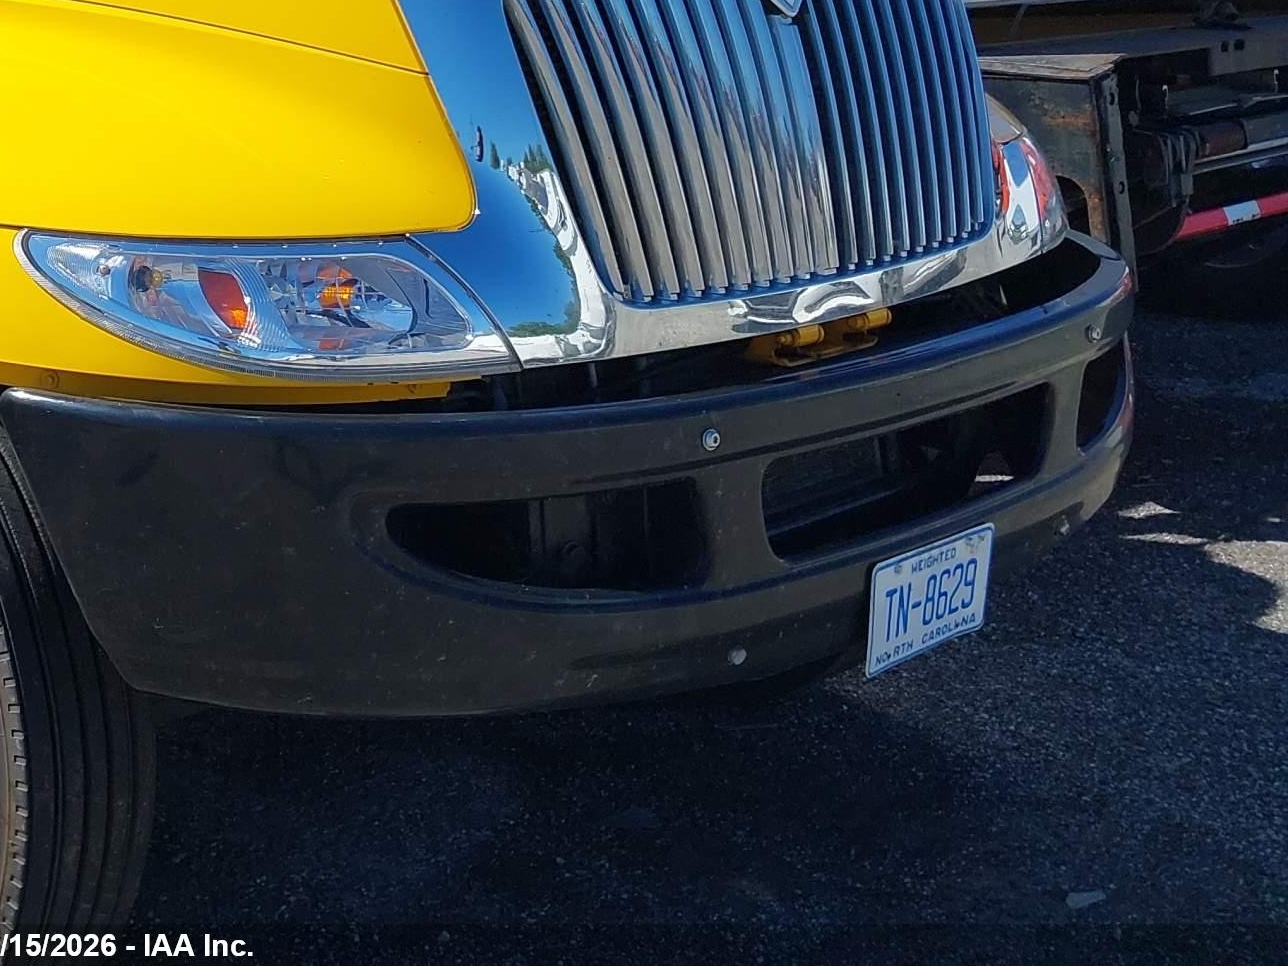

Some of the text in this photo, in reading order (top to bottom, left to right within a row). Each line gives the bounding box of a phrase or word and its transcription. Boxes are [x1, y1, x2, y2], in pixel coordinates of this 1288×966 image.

[911, 547, 957, 574] WEIGHTED
[886, 558, 978, 642] TN-8629
[875, 613, 976, 666] NORTH CAROLINA
